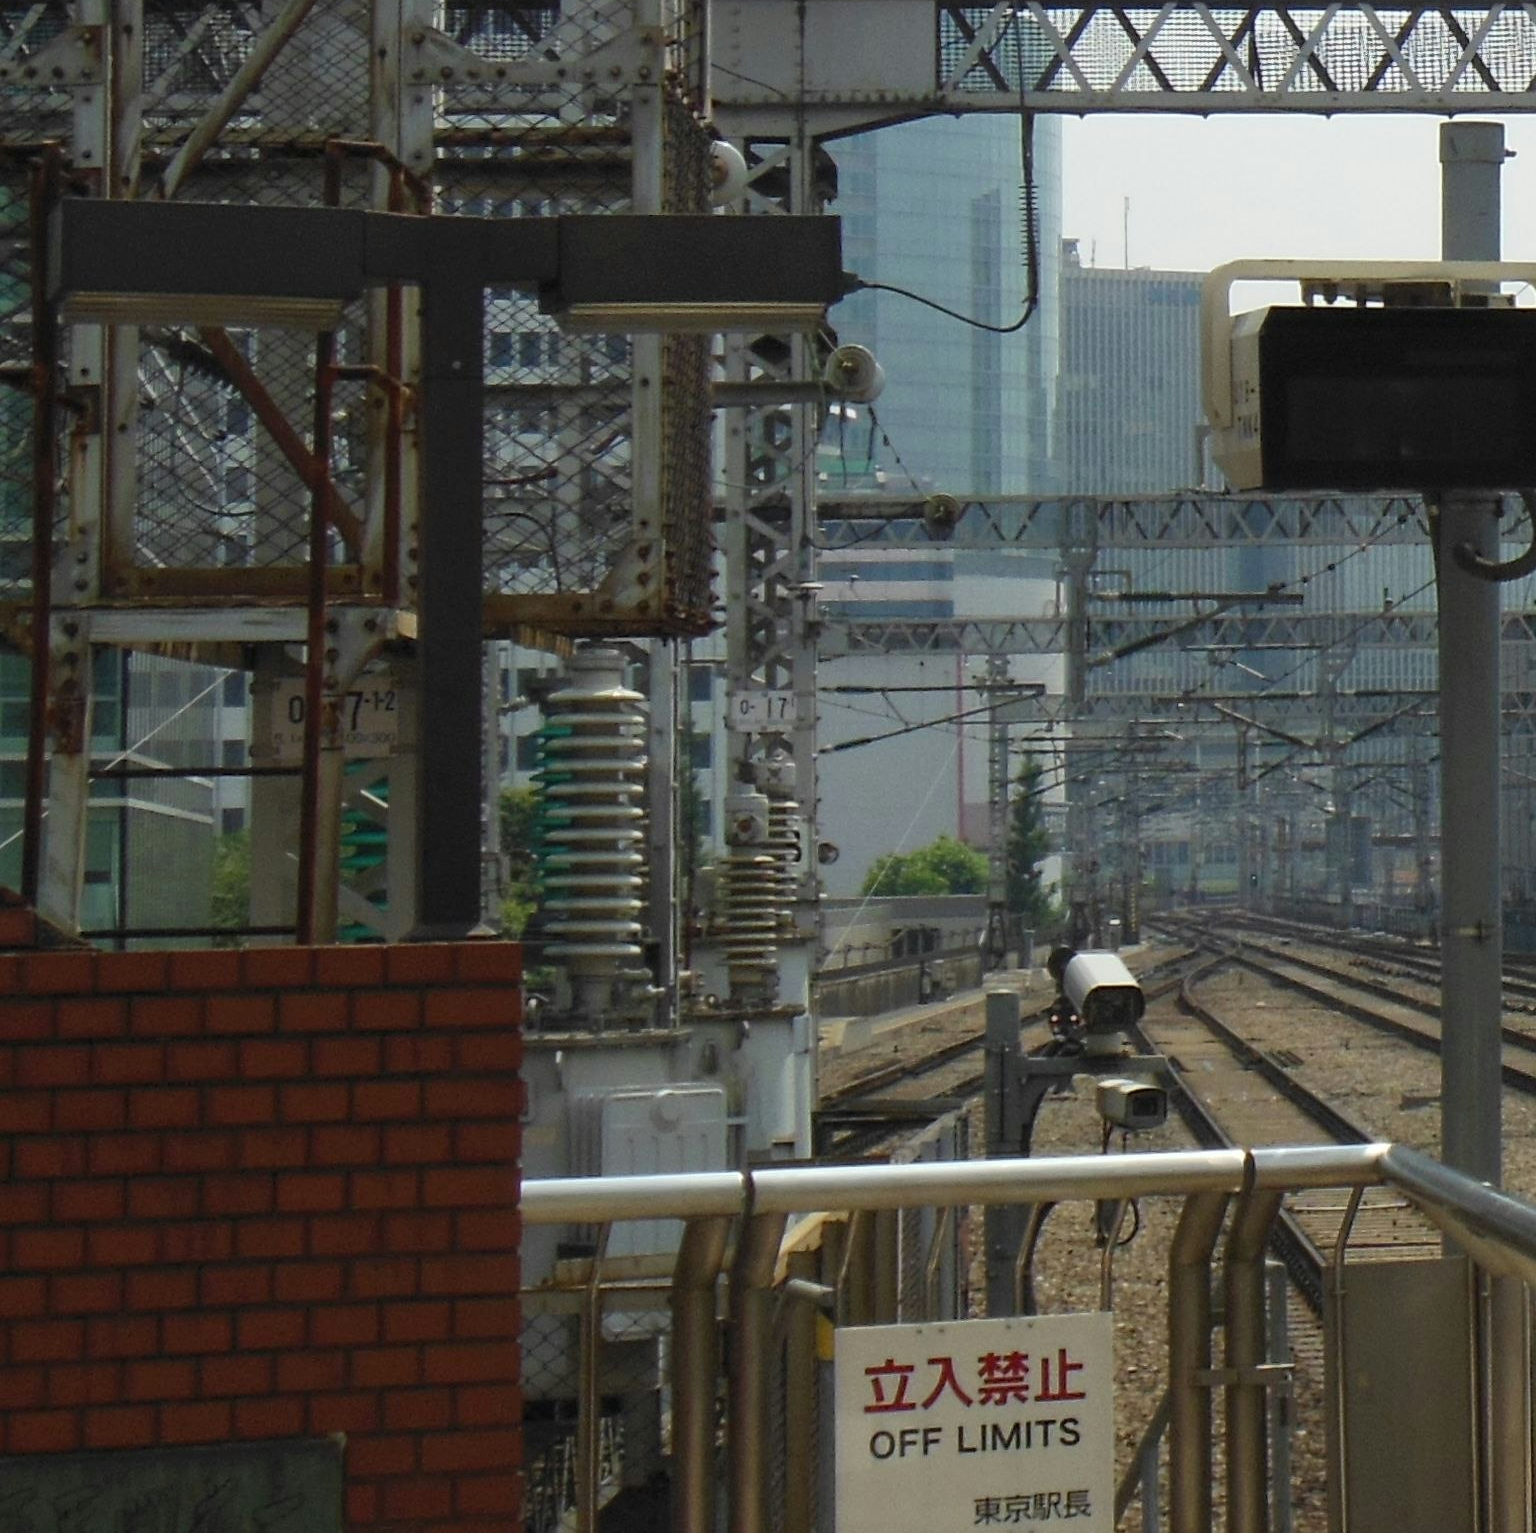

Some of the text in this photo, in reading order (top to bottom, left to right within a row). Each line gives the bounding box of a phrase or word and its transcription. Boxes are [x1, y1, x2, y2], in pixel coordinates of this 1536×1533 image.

[863, 1348, 1087, 1414] 立入禁止
[869, 1417, 1081, 1460] OFF LIMITS
[973, 1489, 1092, 1525] 東京駅長
